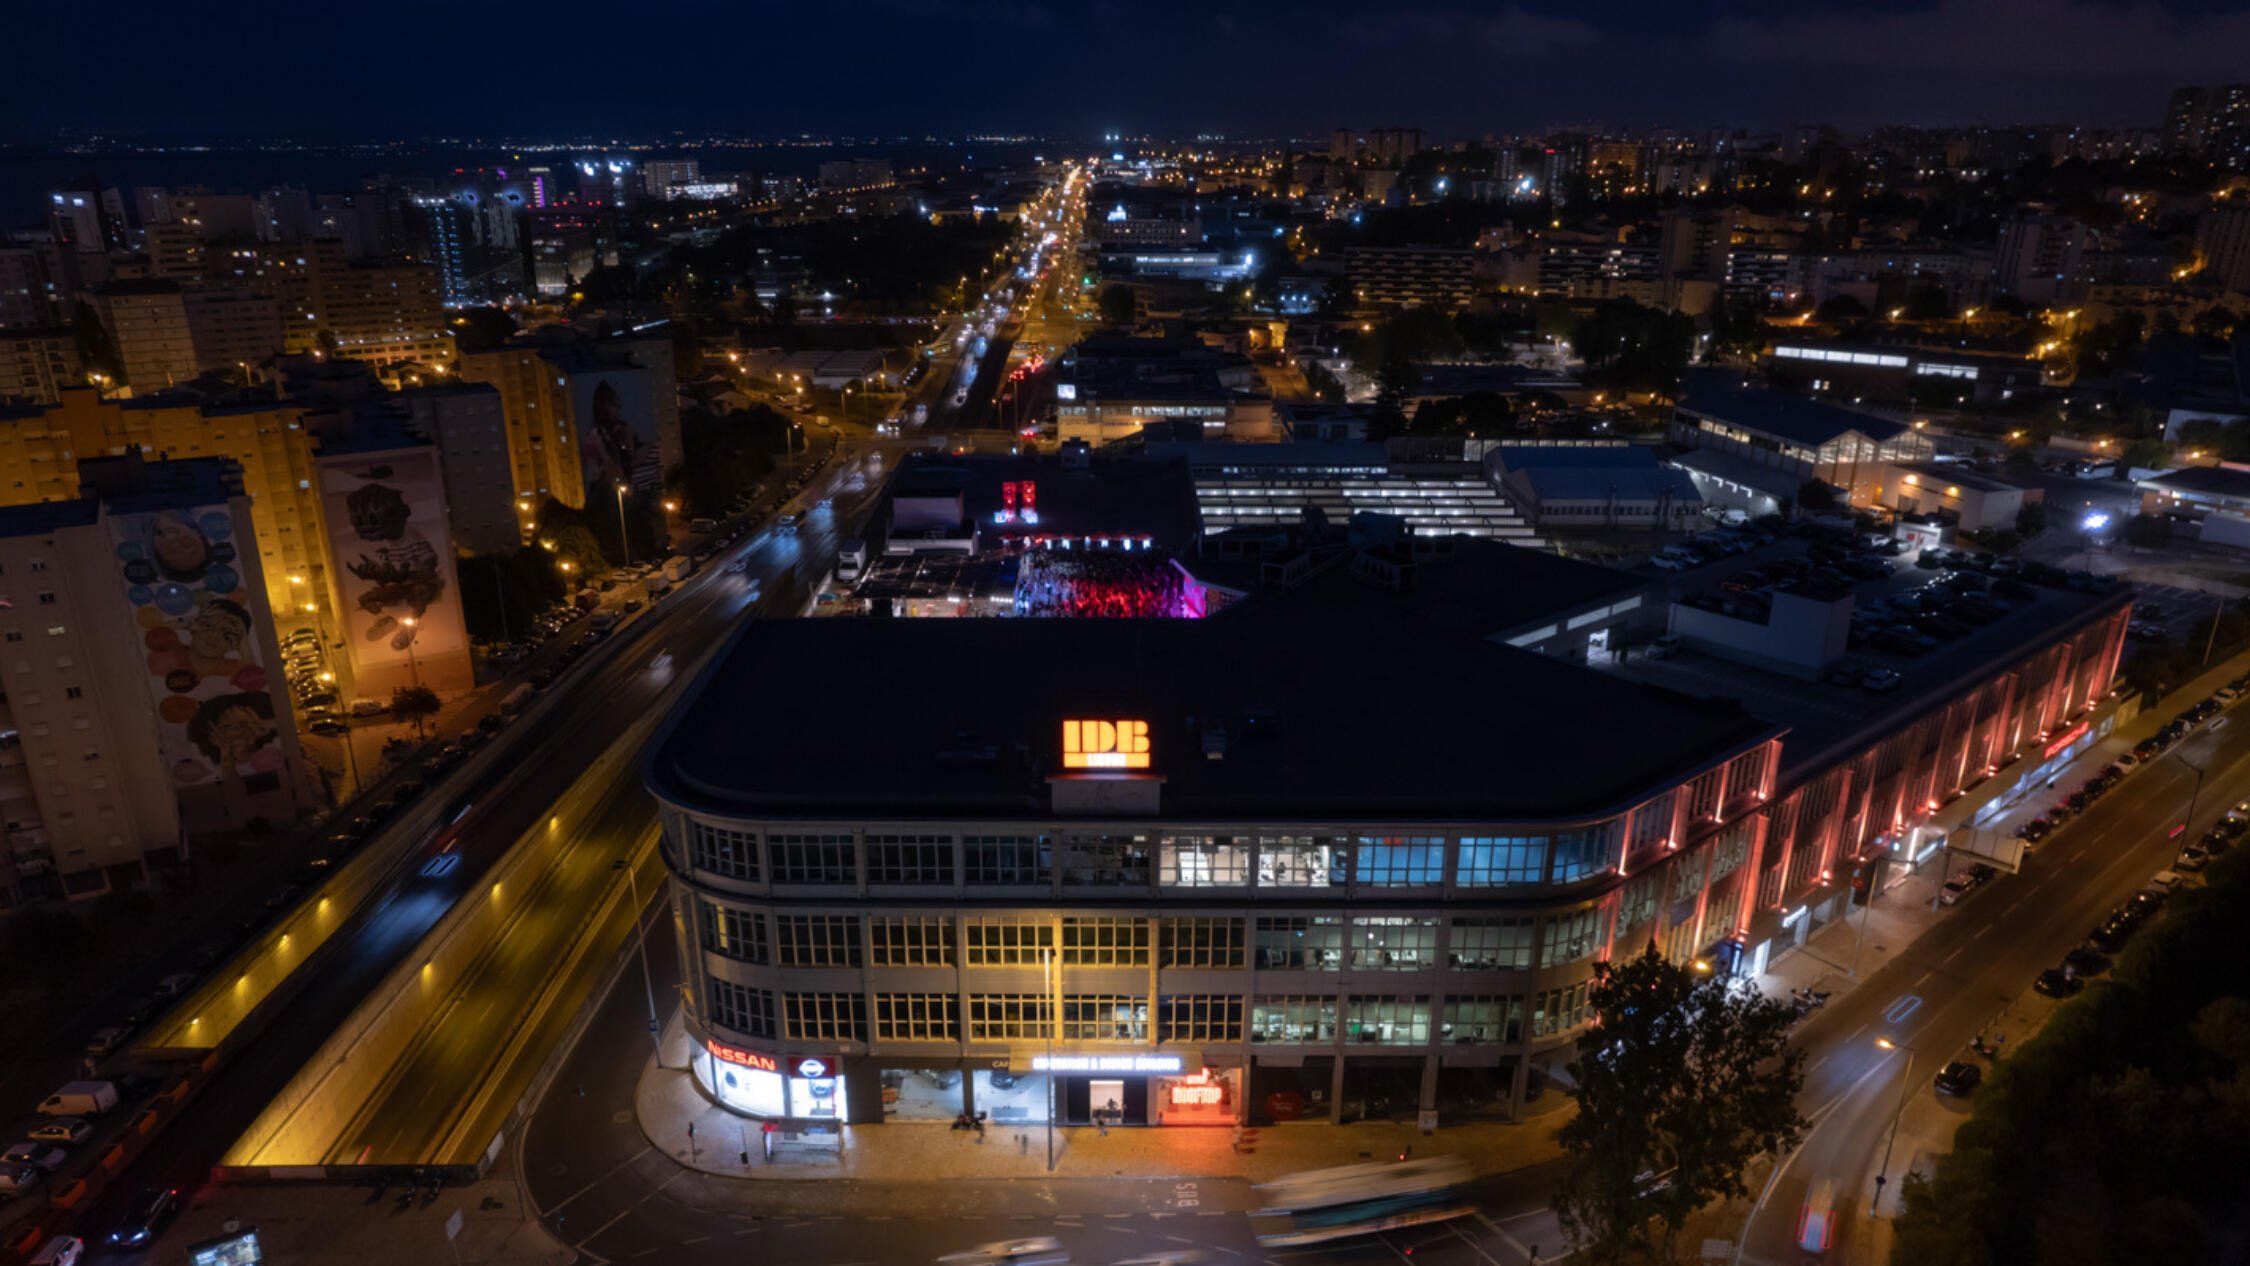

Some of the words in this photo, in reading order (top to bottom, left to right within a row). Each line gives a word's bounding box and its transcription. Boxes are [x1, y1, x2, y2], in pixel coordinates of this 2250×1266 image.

[1063, 720, 1150, 753] IDB
[708, 1040, 777, 1071] NISSAN
[1175, 1182, 1200, 1207] BUS
